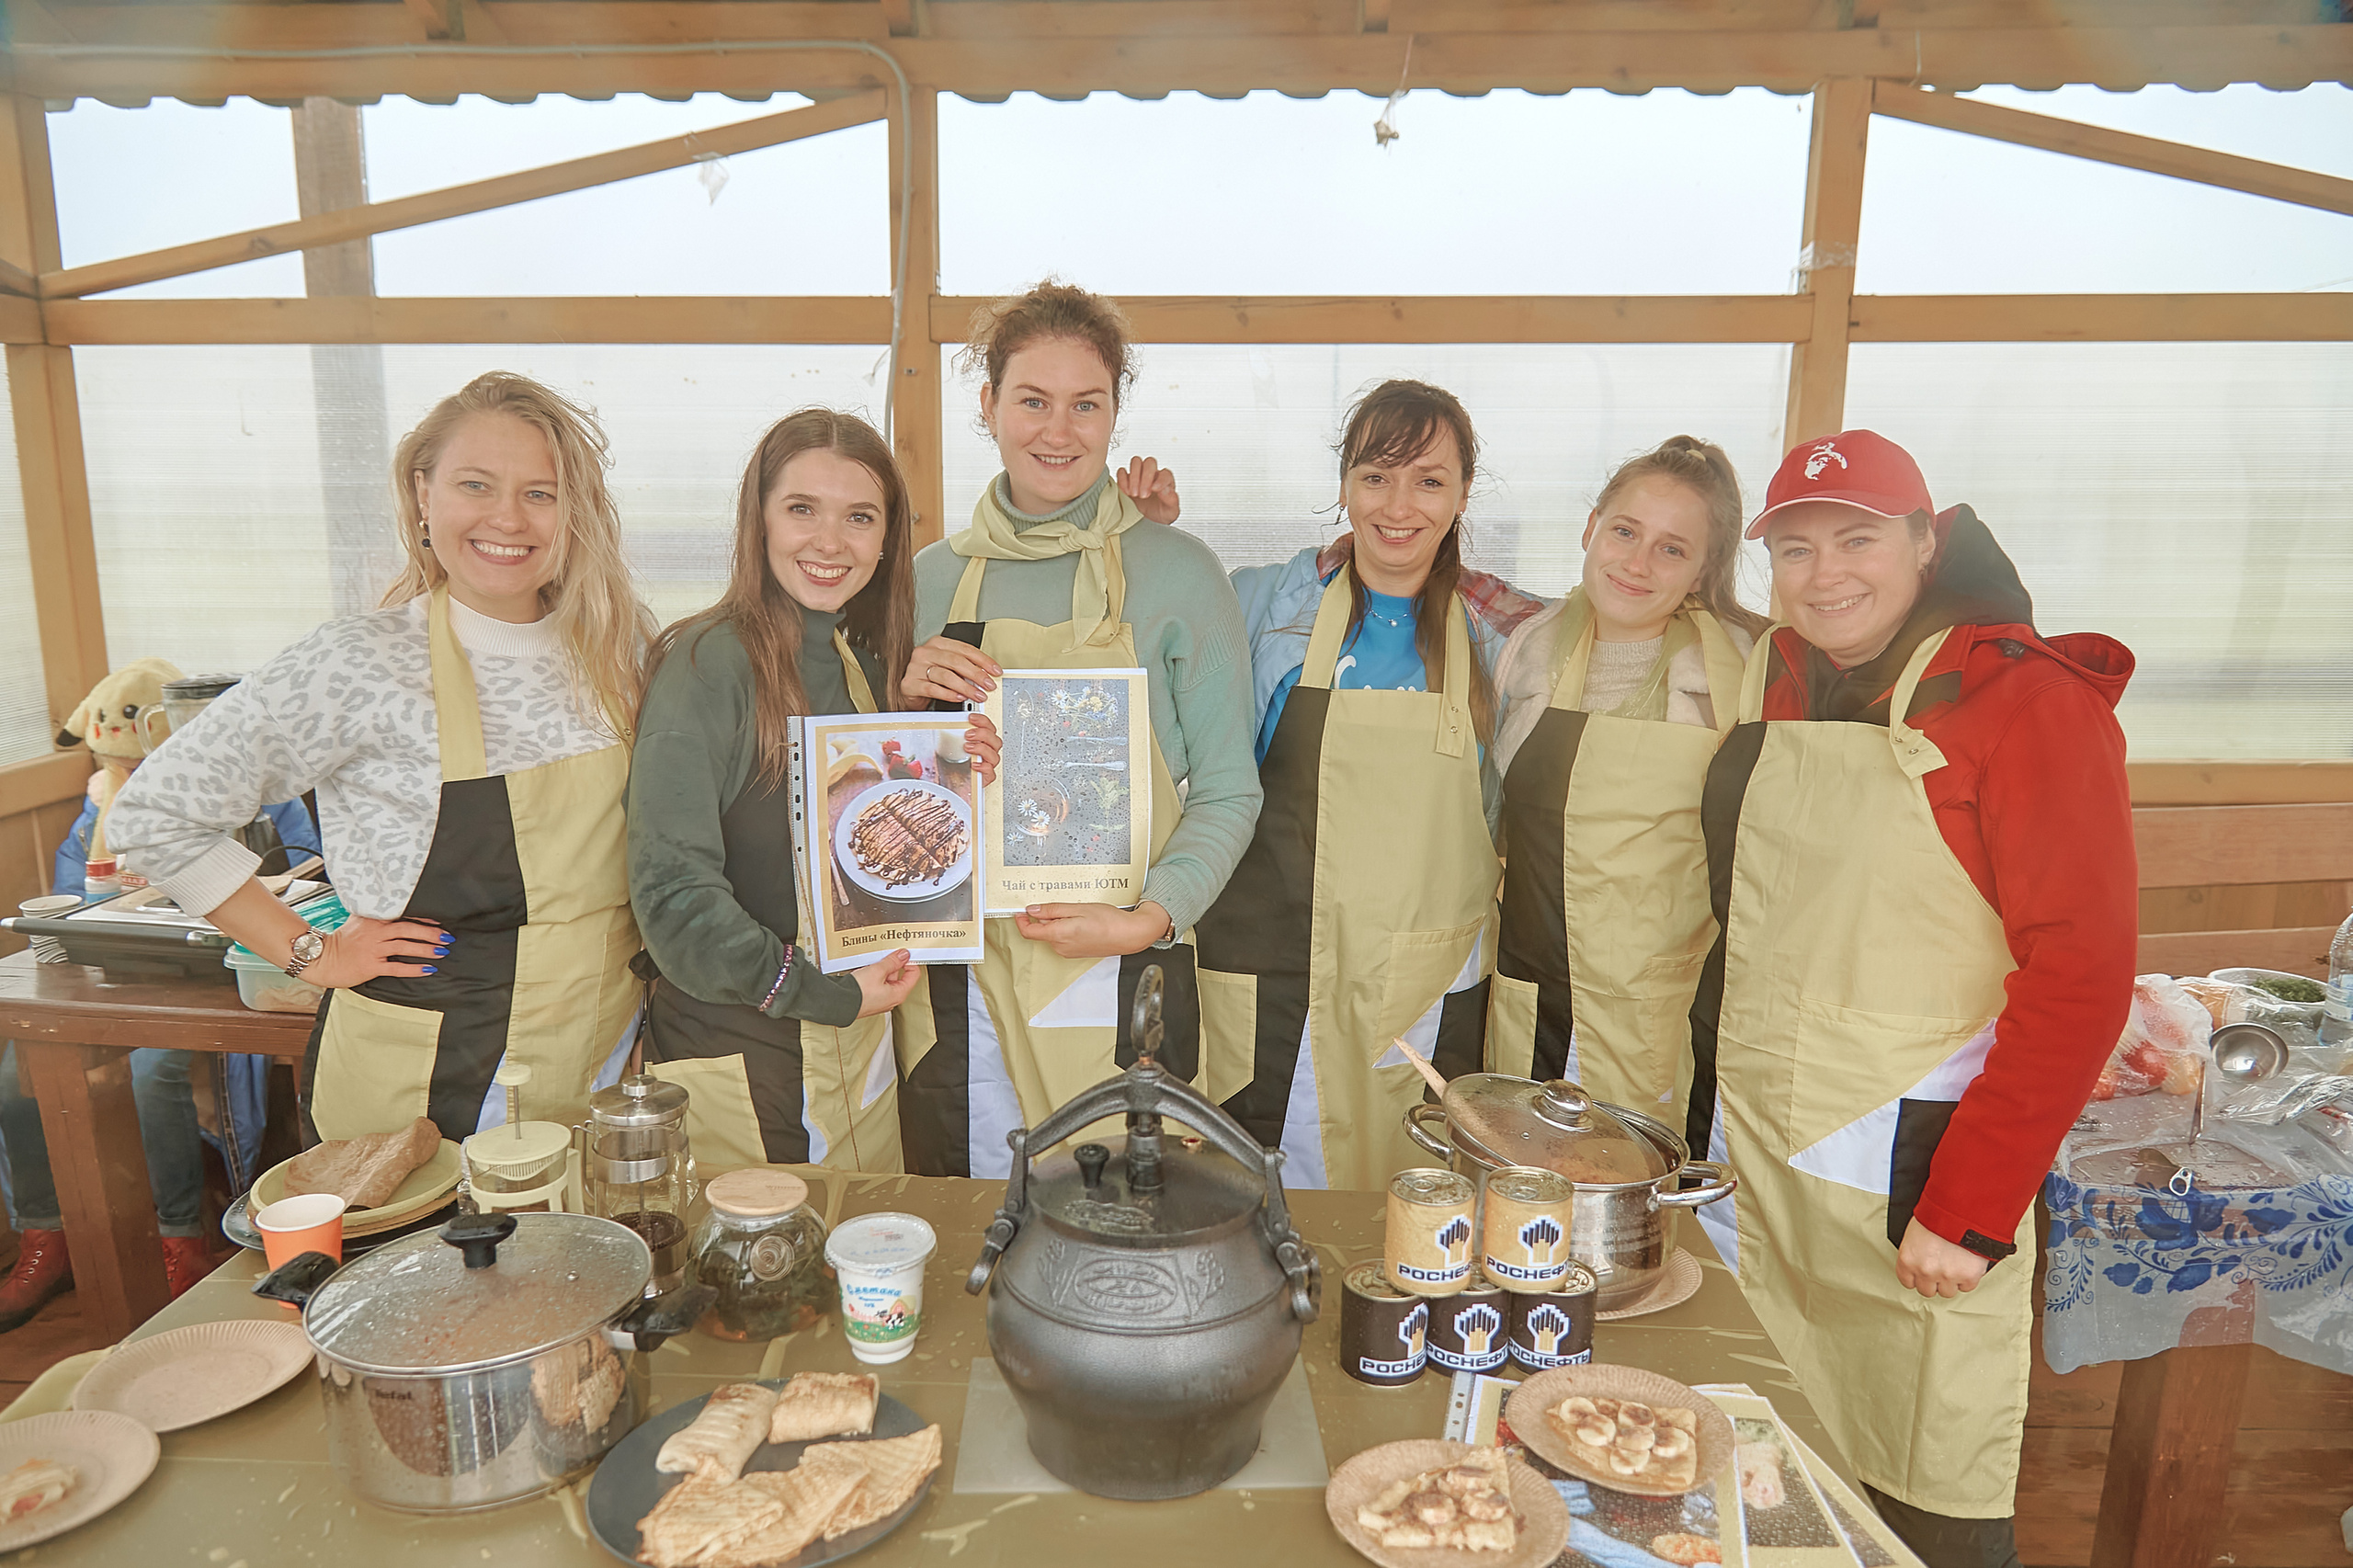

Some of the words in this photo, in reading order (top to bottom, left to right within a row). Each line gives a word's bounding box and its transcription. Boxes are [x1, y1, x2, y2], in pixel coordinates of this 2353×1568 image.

[1002, 880, 1026, 891] Чай
[1029, 881, 1036, 891] с
[1040, 880, 1091, 892] травами
[1095, 878, 1129, 890] ЮТМ
[841, 933, 878, 948] Блины
[880, 928, 967, 942] «Нефтяночка»
[1362, 1353, 1427, 1373] РОСНЕ
